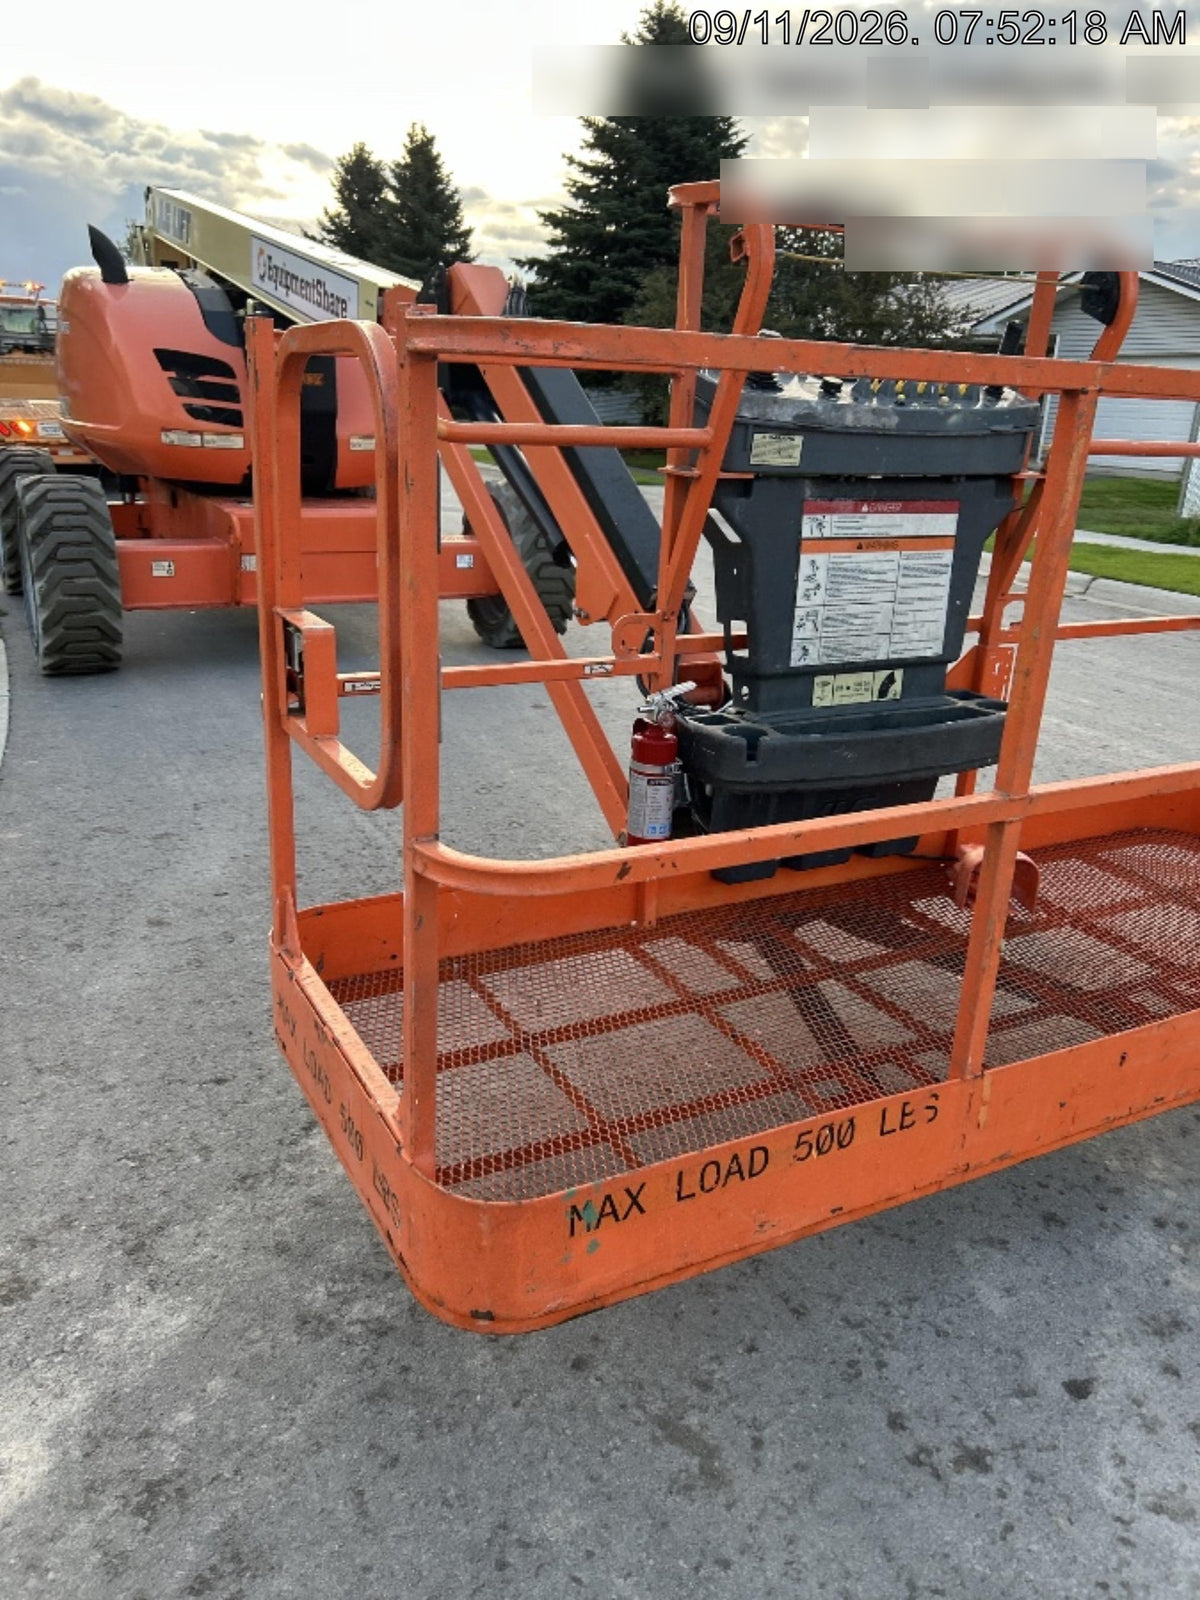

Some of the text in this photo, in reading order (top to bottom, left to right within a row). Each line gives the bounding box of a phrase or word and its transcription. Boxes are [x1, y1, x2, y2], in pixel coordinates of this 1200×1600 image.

[267, 253, 348, 319] EquipmentShare
[569, 1181, 647, 1238] MAX
[675, 1145, 770, 1203] LOAD
[792, 1116, 855, 1162] 500
